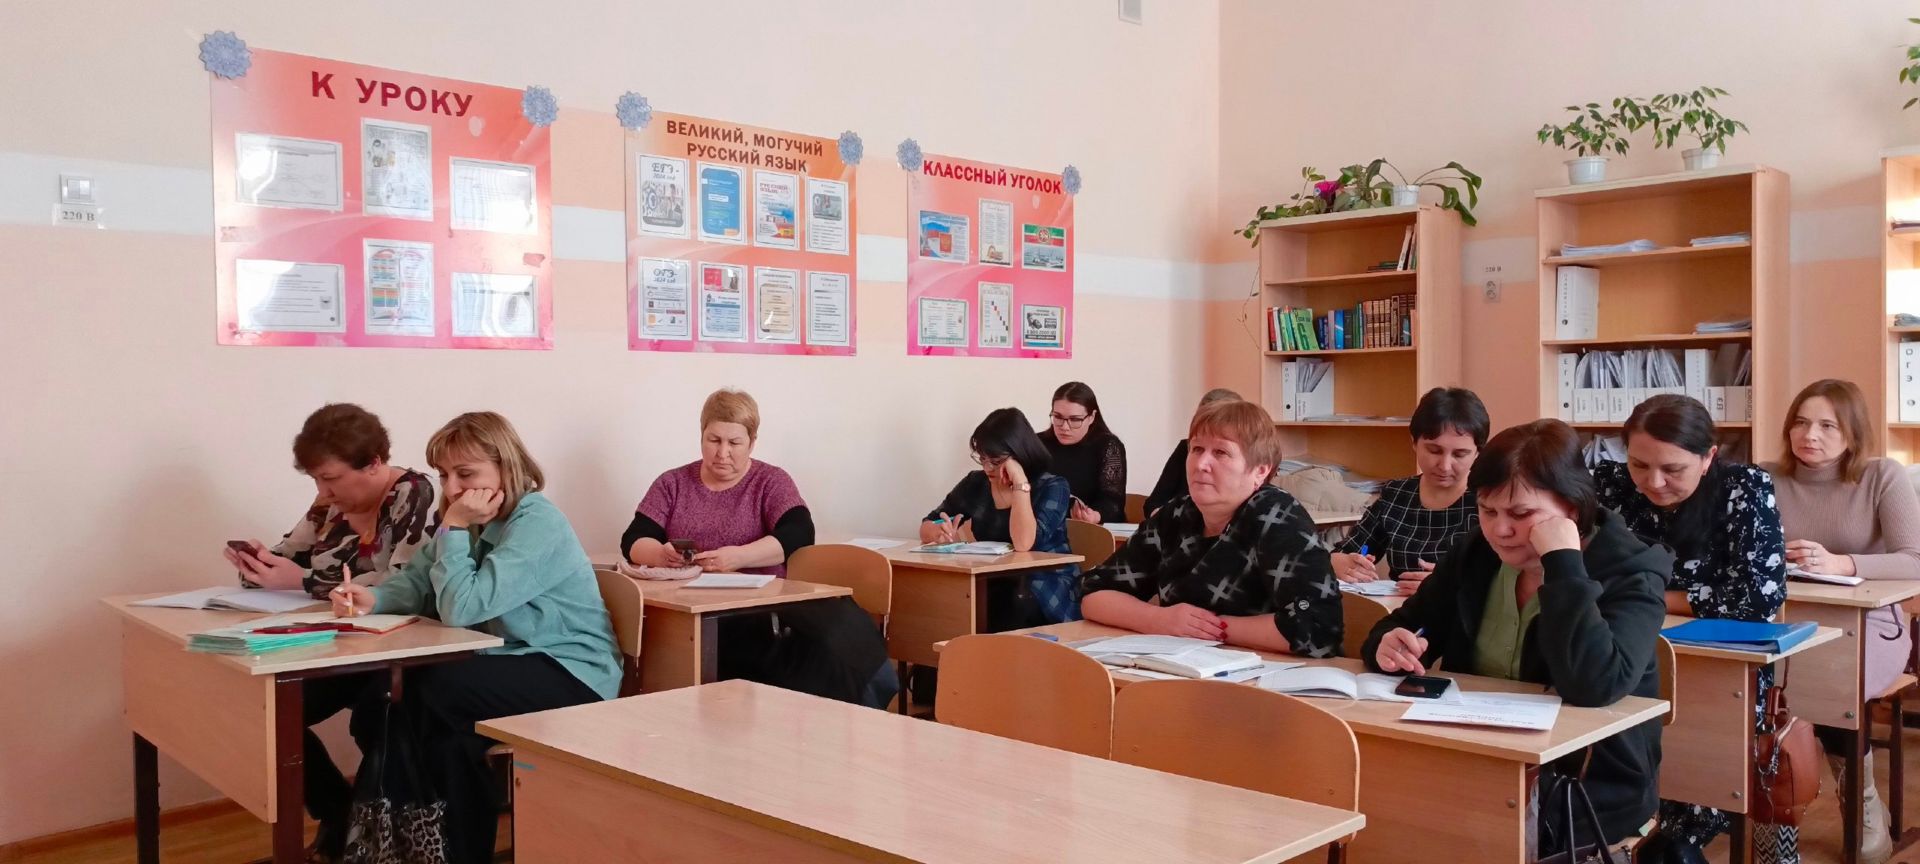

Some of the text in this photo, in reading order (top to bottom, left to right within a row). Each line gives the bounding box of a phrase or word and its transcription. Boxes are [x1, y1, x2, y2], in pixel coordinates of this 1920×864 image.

[310, 71, 474, 117] К УРОКУ
[666, 120, 824, 157] ВЕЛИКИЙ, МОГУЧИЙ
[687, 143, 807, 173] РУССКИЙ ЯЗЫК
[923, 160, 1062, 195] КЛАССНЫЙ УГОЛОК
[62, 210, 95, 222] 220 В
[1297, 323, 1310, 350] 6
